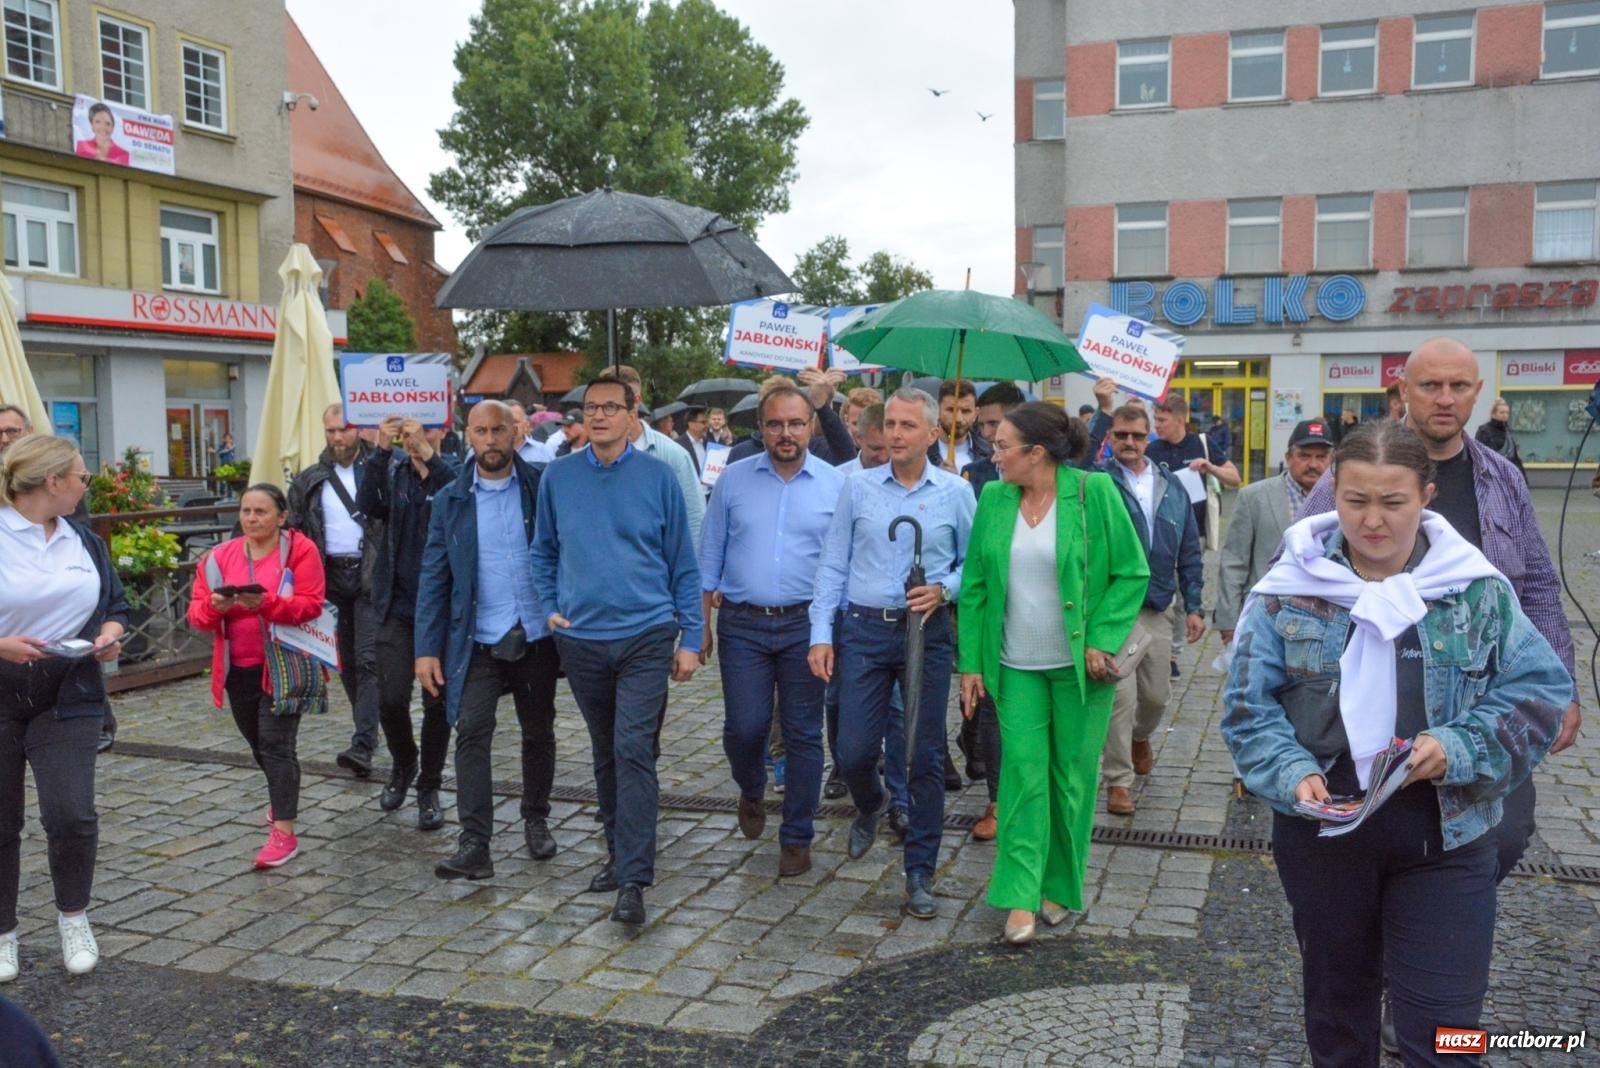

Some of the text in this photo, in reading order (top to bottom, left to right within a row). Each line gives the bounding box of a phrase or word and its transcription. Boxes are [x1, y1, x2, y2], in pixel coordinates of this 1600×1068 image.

[1388, 279, 1600, 319] zaprasza
[132, 293, 277, 329] ROSSMANN
[759, 320, 798, 335] PAWEŁ
[734, 329, 820, 352] JABŁOŃSKI
[1111, 335, 1149, 356] PAWEŁ
[1082, 338, 1168, 379] JABŁOŃSKI
[1521, 362, 1556, 373] Bliski
[1342, 365, 1374, 376] Bliski
[375, 377, 419, 388] PAWEŁ
[349, 388, 445, 404] JABŁOŃSKI
